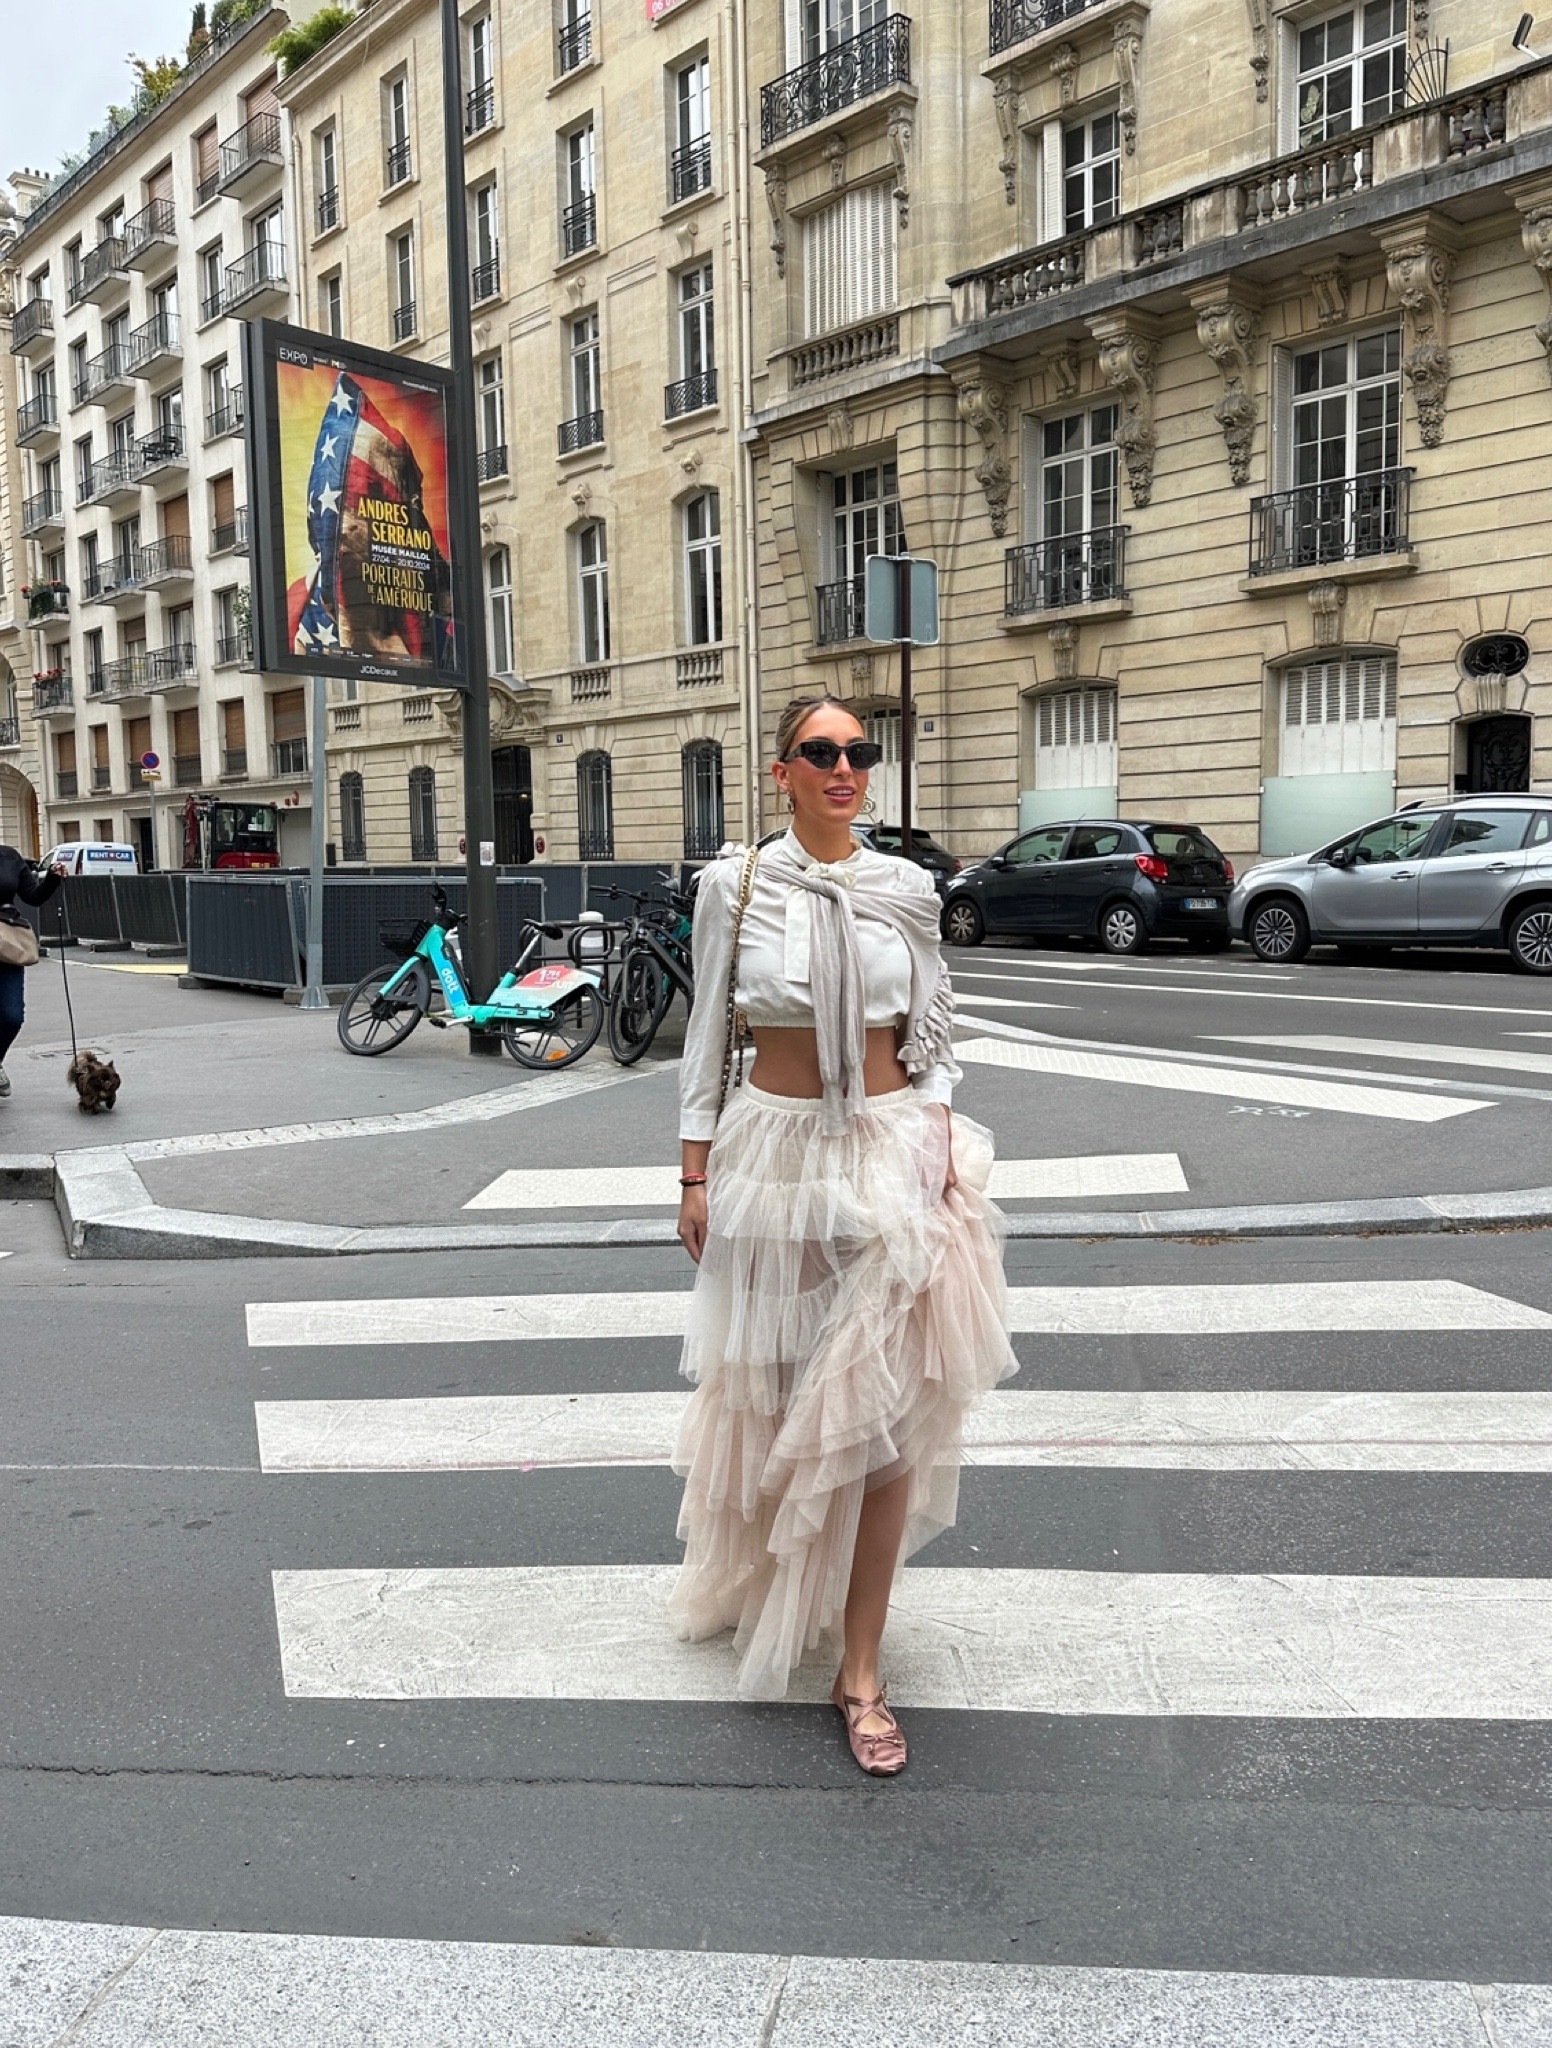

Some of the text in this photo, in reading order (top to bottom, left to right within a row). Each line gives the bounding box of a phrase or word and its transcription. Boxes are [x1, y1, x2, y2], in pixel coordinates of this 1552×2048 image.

[279, 348, 308, 365] EXPO
[358, 497, 409, 525] ANDRES
[372, 521, 431, 550] SERRANO
[371, 544, 431, 561] MUSÉE MAILLOL
[362, 562, 425, 591] PORTRAITS
[360, 665, 399, 677] JCDecaux
[442, 968, 459, 994] dott
